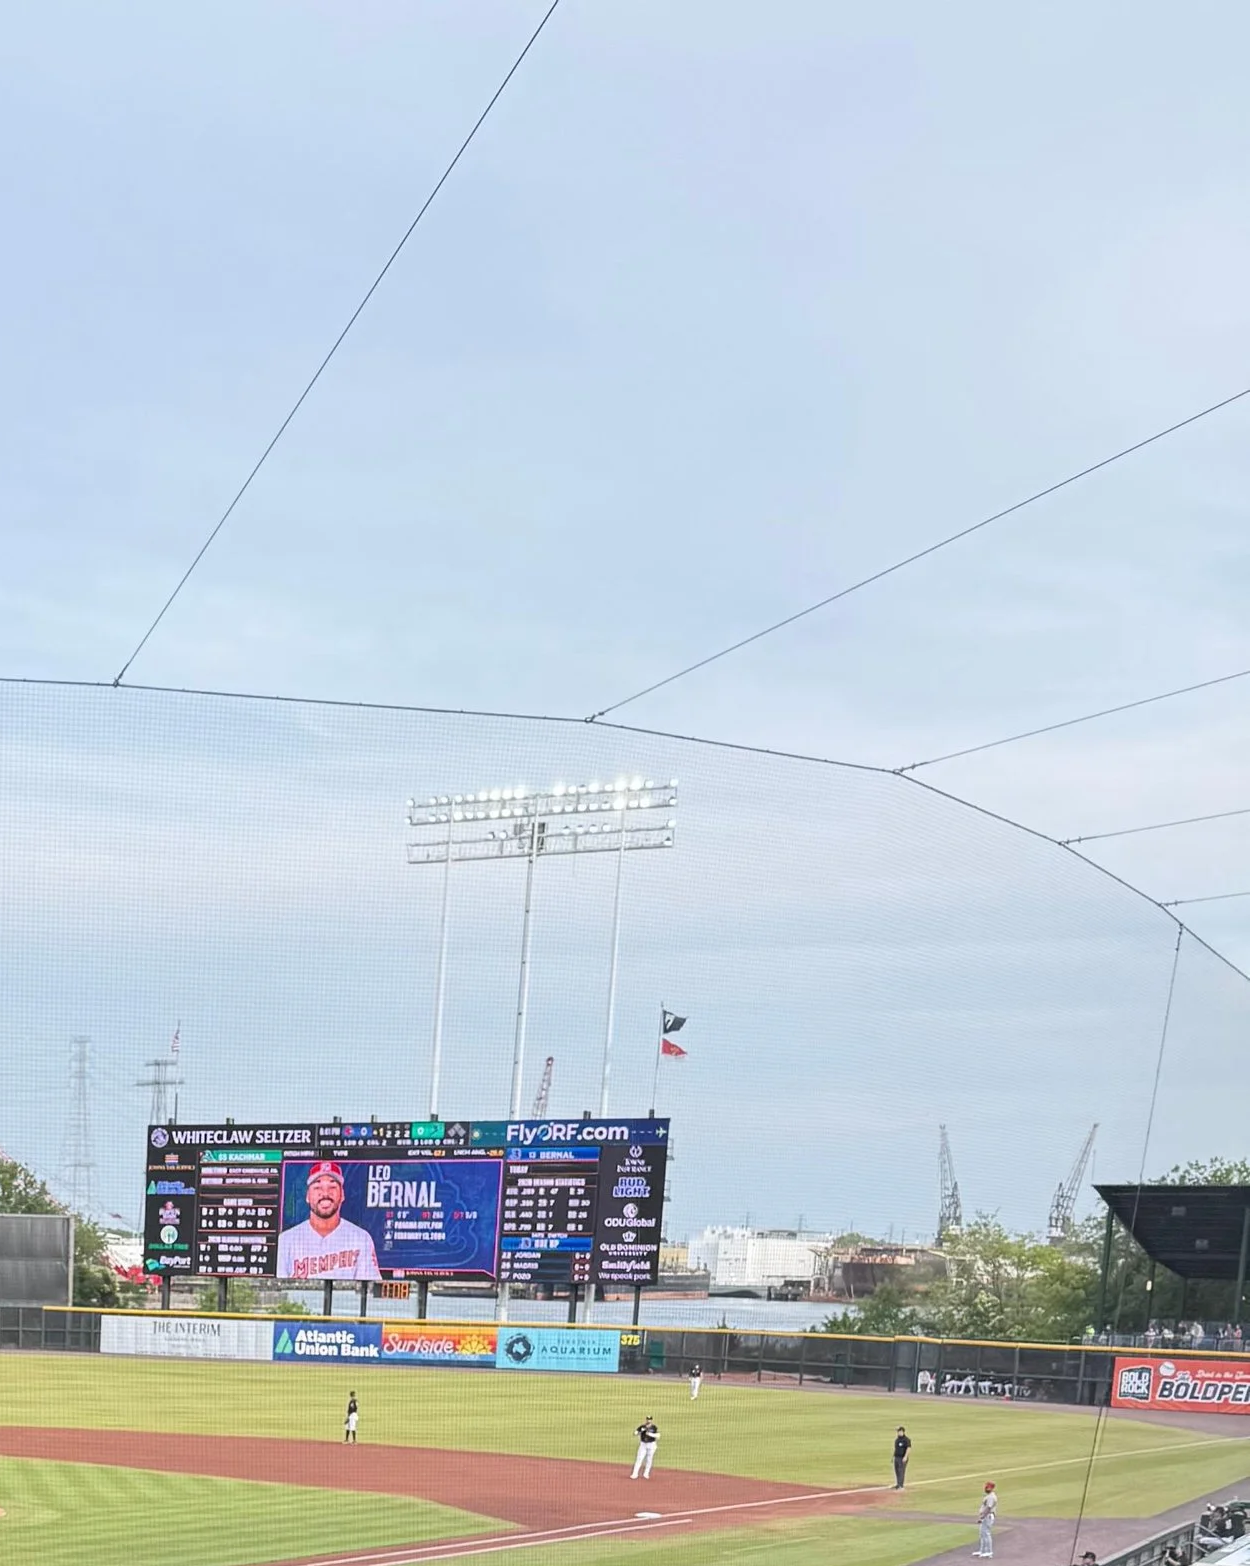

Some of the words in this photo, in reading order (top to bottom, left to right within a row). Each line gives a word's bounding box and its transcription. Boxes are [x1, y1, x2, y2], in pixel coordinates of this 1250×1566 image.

[171, 1130, 253, 1145] WHITECLAW
[255, 1129, 311, 1144] SELTZER
[506, 1121, 629, 1145] FlyORF.com
[539, 1151, 574, 1159] BERNAL
[368, 1165, 391, 1181] LEO
[618, 1177, 646, 1188] BUD
[366, 1181, 442, 1208] BERNAL
[612, 1187, 650, 1198] LIGHT
[600, 1243, 616, 1252] OLD
[617, 1243, 658, 1252] DOMINION
[602, 1261, 651, 1273] Smithfield
[152, 1321, 171, 1334] THE
[174, 1321, 221, 1337] INTERIM
[295, 1329, 355, 1344] Atlantic
[620, 1334, 641, 1346] 375
[294, 1342, 338, 1356] Union
[341, 1343, 379, 1357] Bank
[383, 1333, 454, 1355] Surfside
[541, 1345, 611, 1355] AQUARIUM
[1122, 1371, 1150, 1382] BOLD
[1121, 1380, 1149, 1394] ROCK
